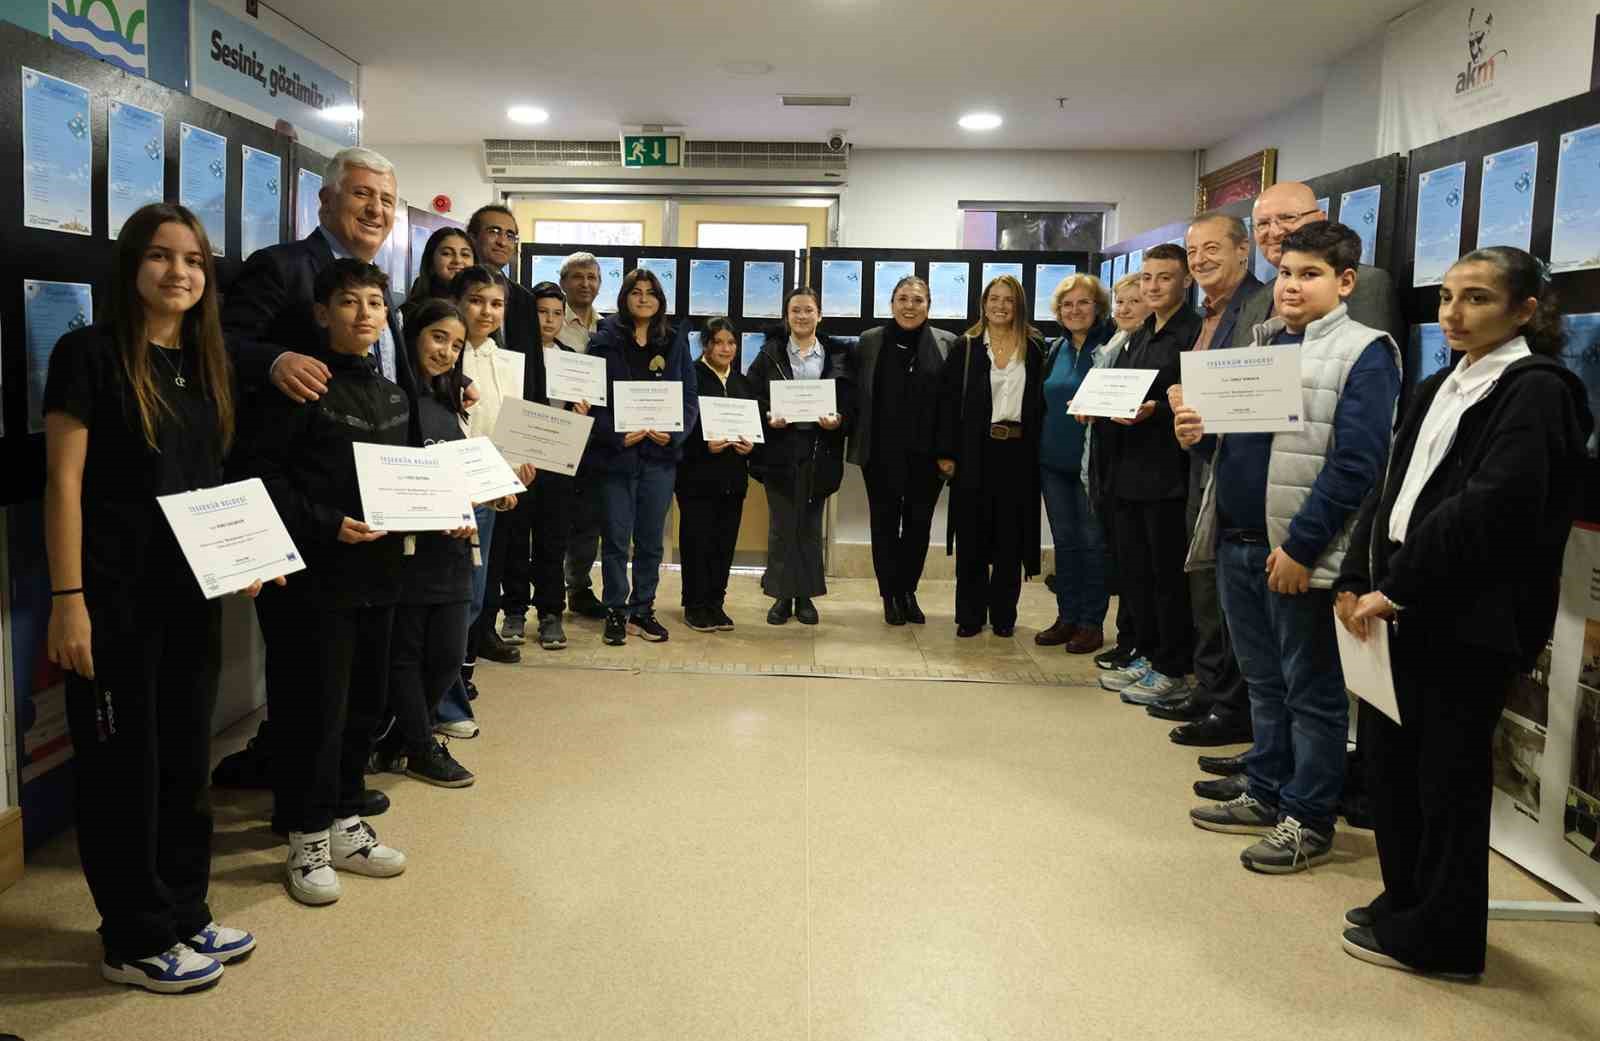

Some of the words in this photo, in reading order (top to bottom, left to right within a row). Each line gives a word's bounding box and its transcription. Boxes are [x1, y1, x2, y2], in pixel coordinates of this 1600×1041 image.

[210, 29, 267, 88] Sesiniz,
[269, 64, 324, 110] gözümüz
[1455, 60, 1495, 94] akm
